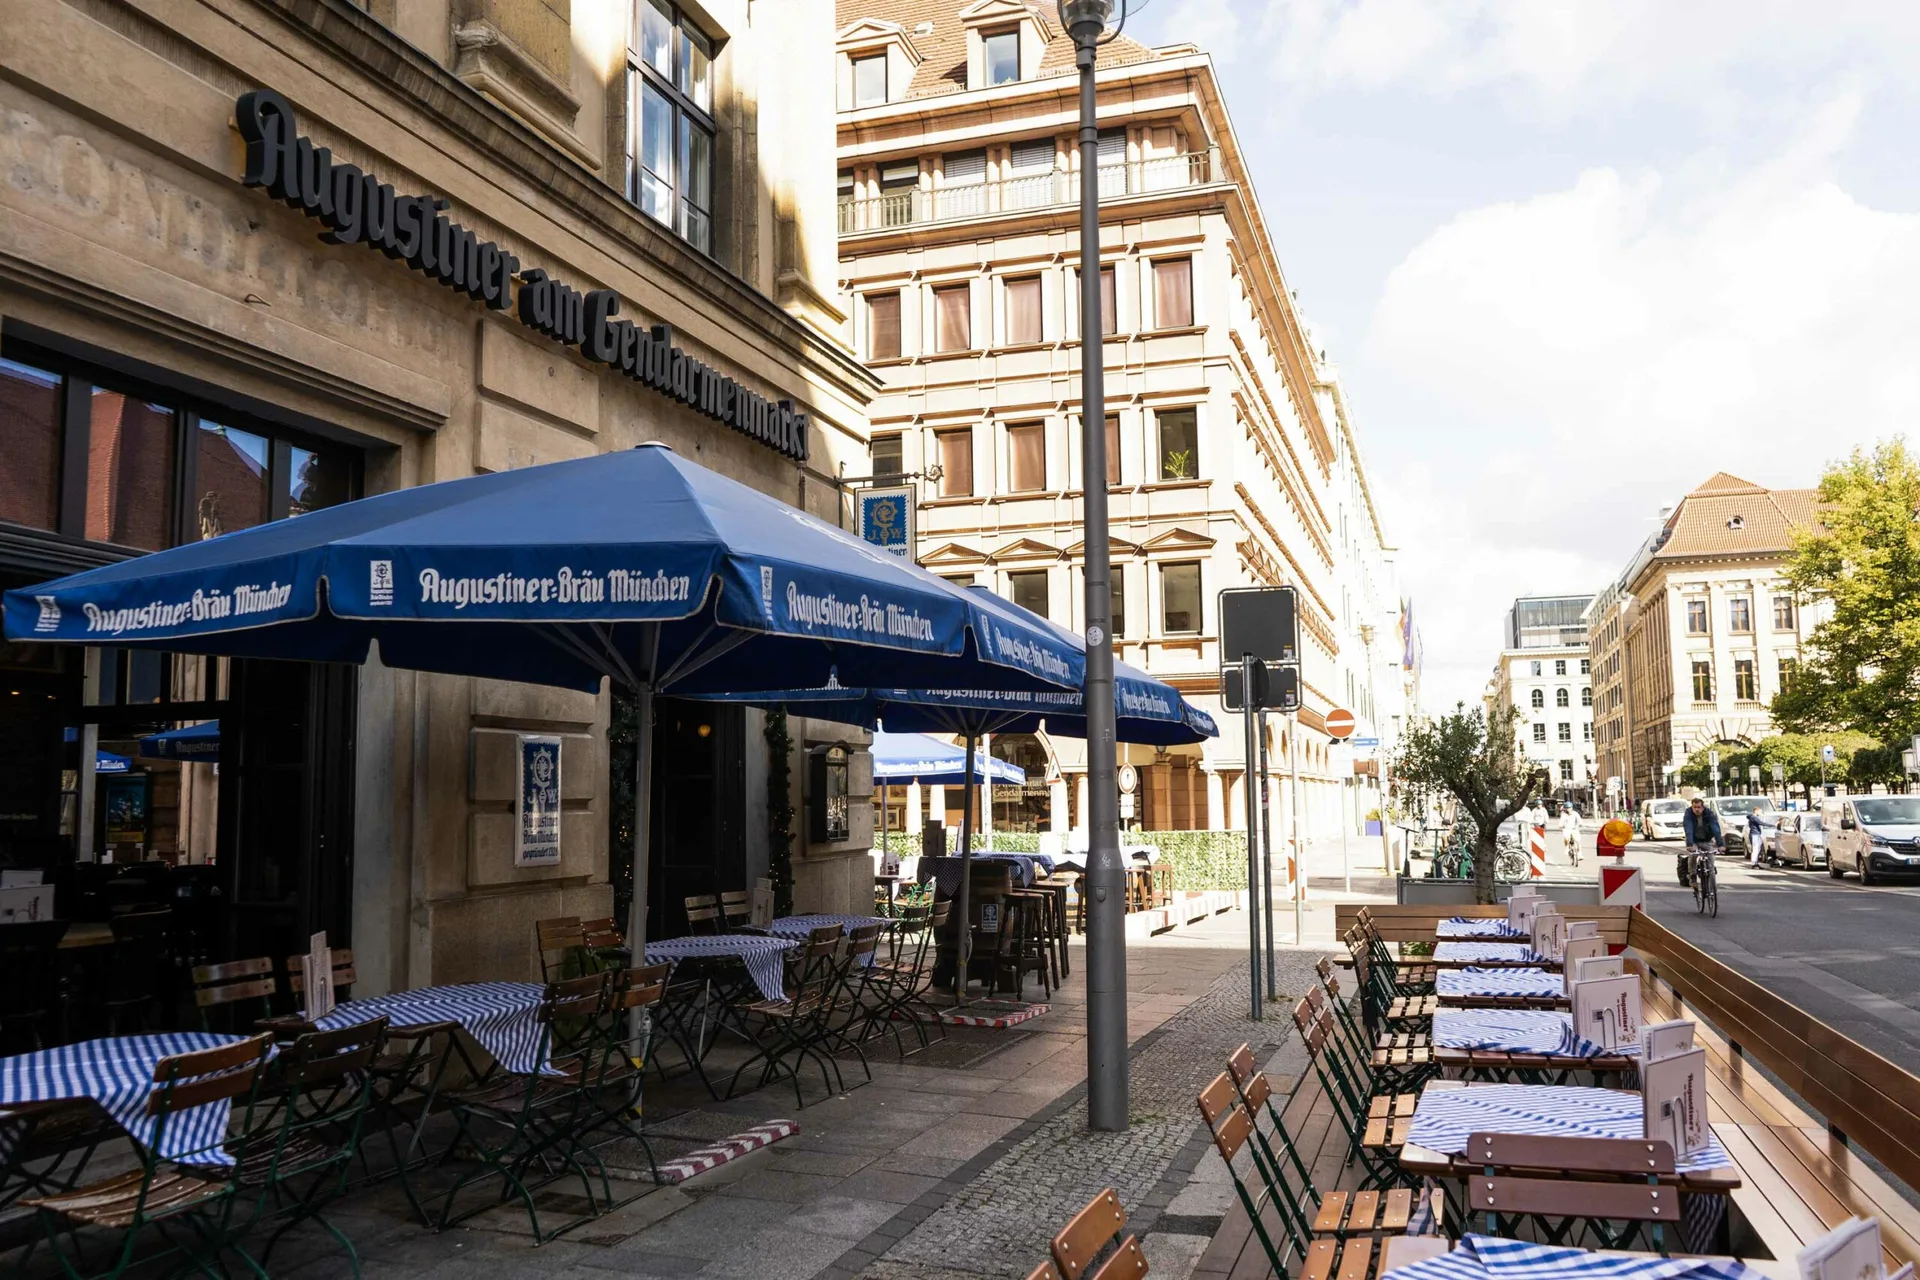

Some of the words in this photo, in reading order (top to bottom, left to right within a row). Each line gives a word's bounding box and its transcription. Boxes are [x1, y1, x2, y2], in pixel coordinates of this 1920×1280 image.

[236, 88, 520, 311] Augustiner
[517, 267, 587, 346] am
[579, 289, 811, 462] Gendarmenmarkt
[607, 568, 690, 602] München
